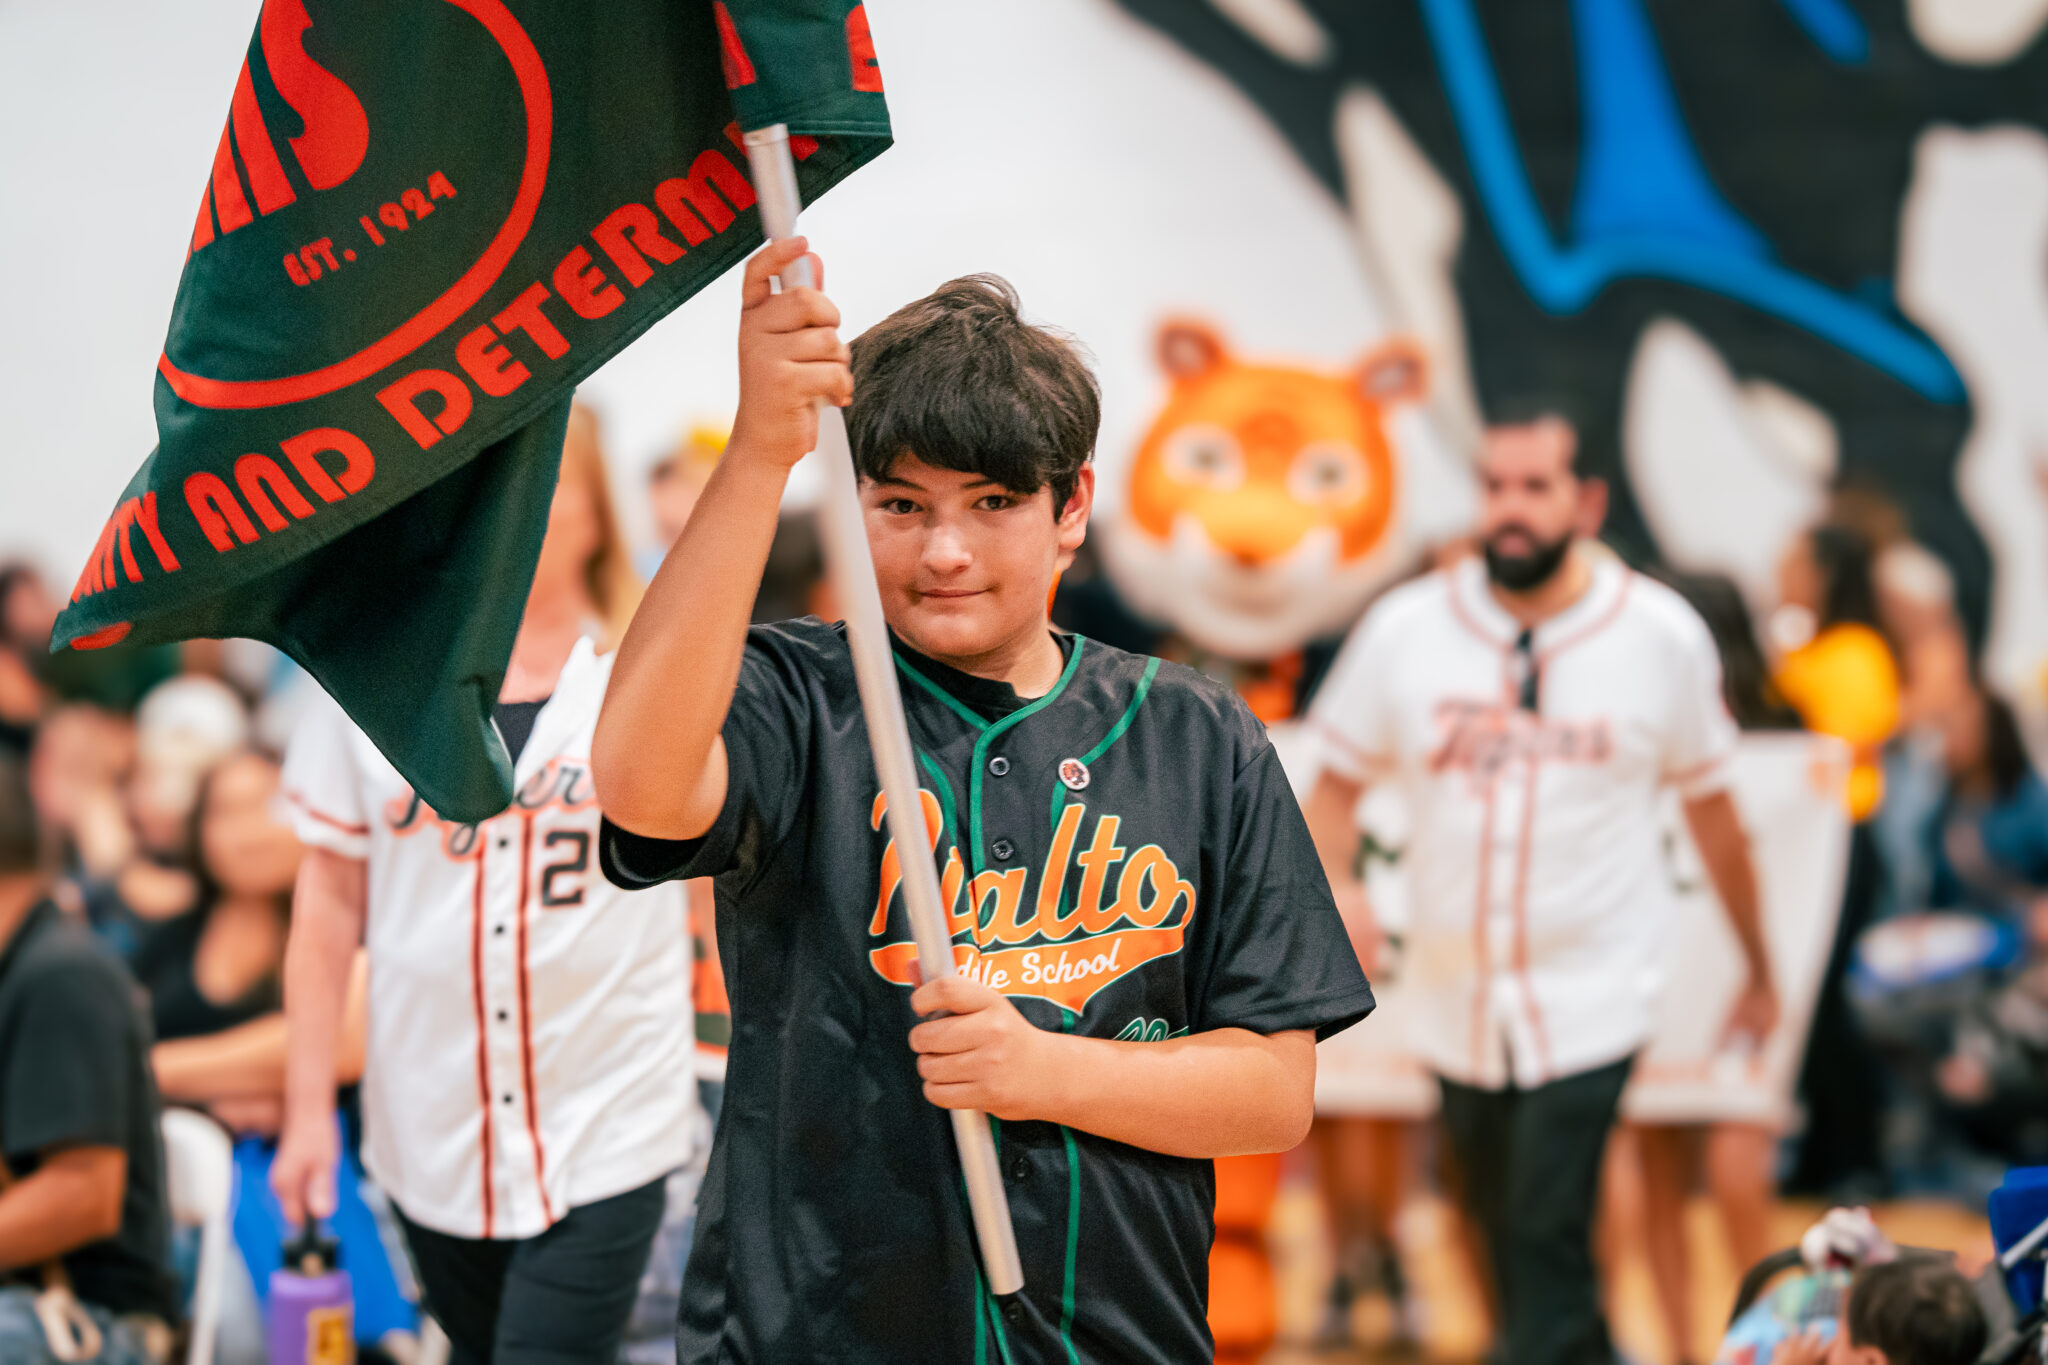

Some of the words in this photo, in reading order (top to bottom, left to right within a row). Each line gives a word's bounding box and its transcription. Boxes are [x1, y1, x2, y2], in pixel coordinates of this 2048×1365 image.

[283, 237, 357, 286] EST.
[359, 170, 458, 246] 1924
[184, 427, 375, 553] AND
[542, 831, 589, 907] 2
[1021, 938, 1122, 985] School
